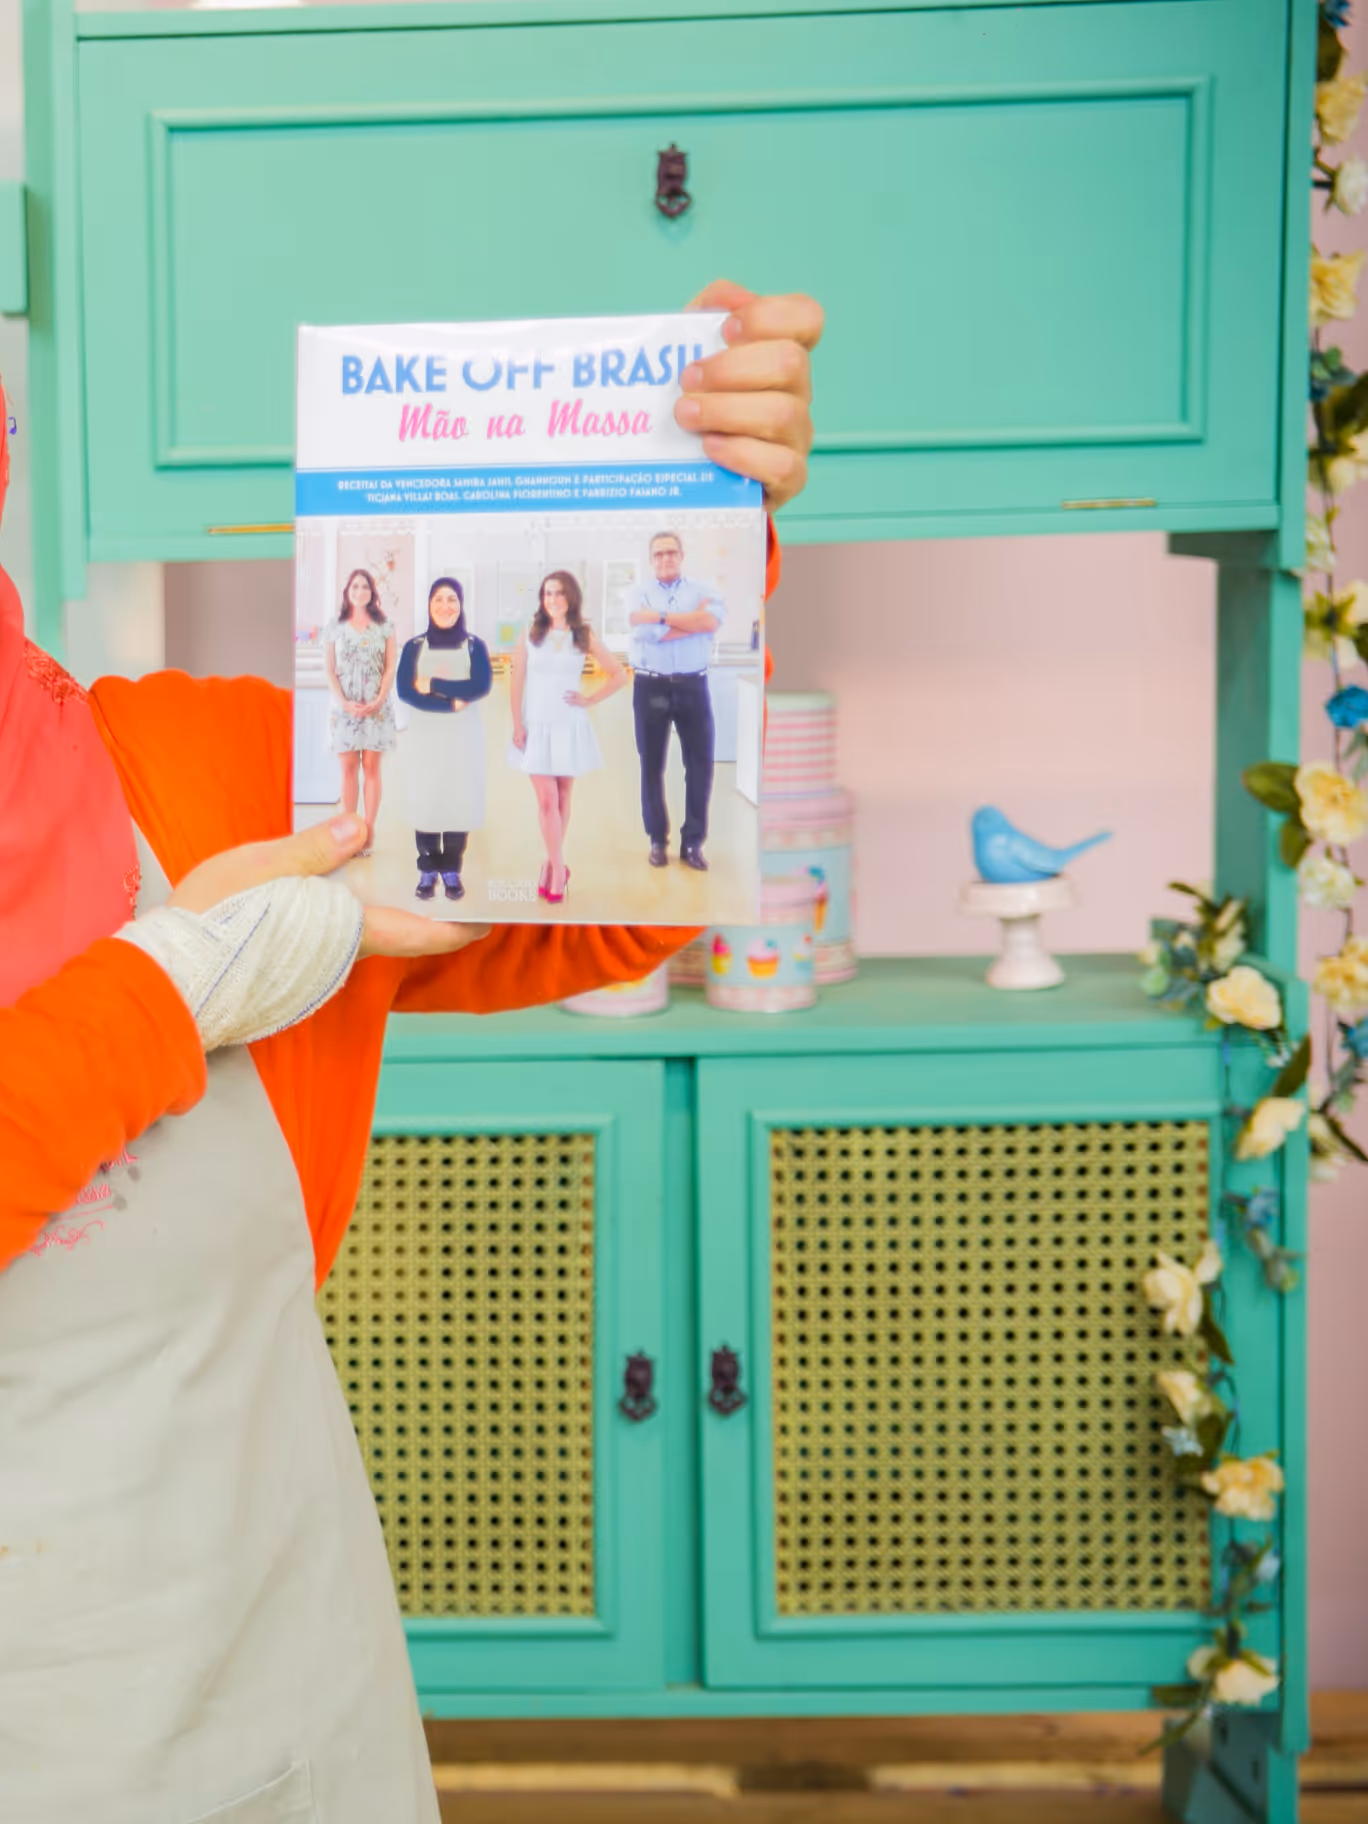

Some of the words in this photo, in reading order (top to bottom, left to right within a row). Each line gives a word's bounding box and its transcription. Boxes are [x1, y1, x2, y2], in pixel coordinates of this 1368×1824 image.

[341, 353, 447, 395] BAKE
[461, 350, 555, 392] OFF
[398, 403, 468, 441] Mão
[487, 414, 525, 440] na
[548, 399, 651, 438] Massa
[338, 480, 378, 490] RECEITAS
[380, 480, 393, 489] DA
[395, 478, 451, 489] VENCEDORA
[583, 471, 652, 485] PARTICIPAÇÃO
[655, 472, 697, 483] ESPECIAL
[701, 471, 714, 482] DE
[463, 489, 510, 500] CAROLINA
[514, 488, 571, 499] FIORENTINO
